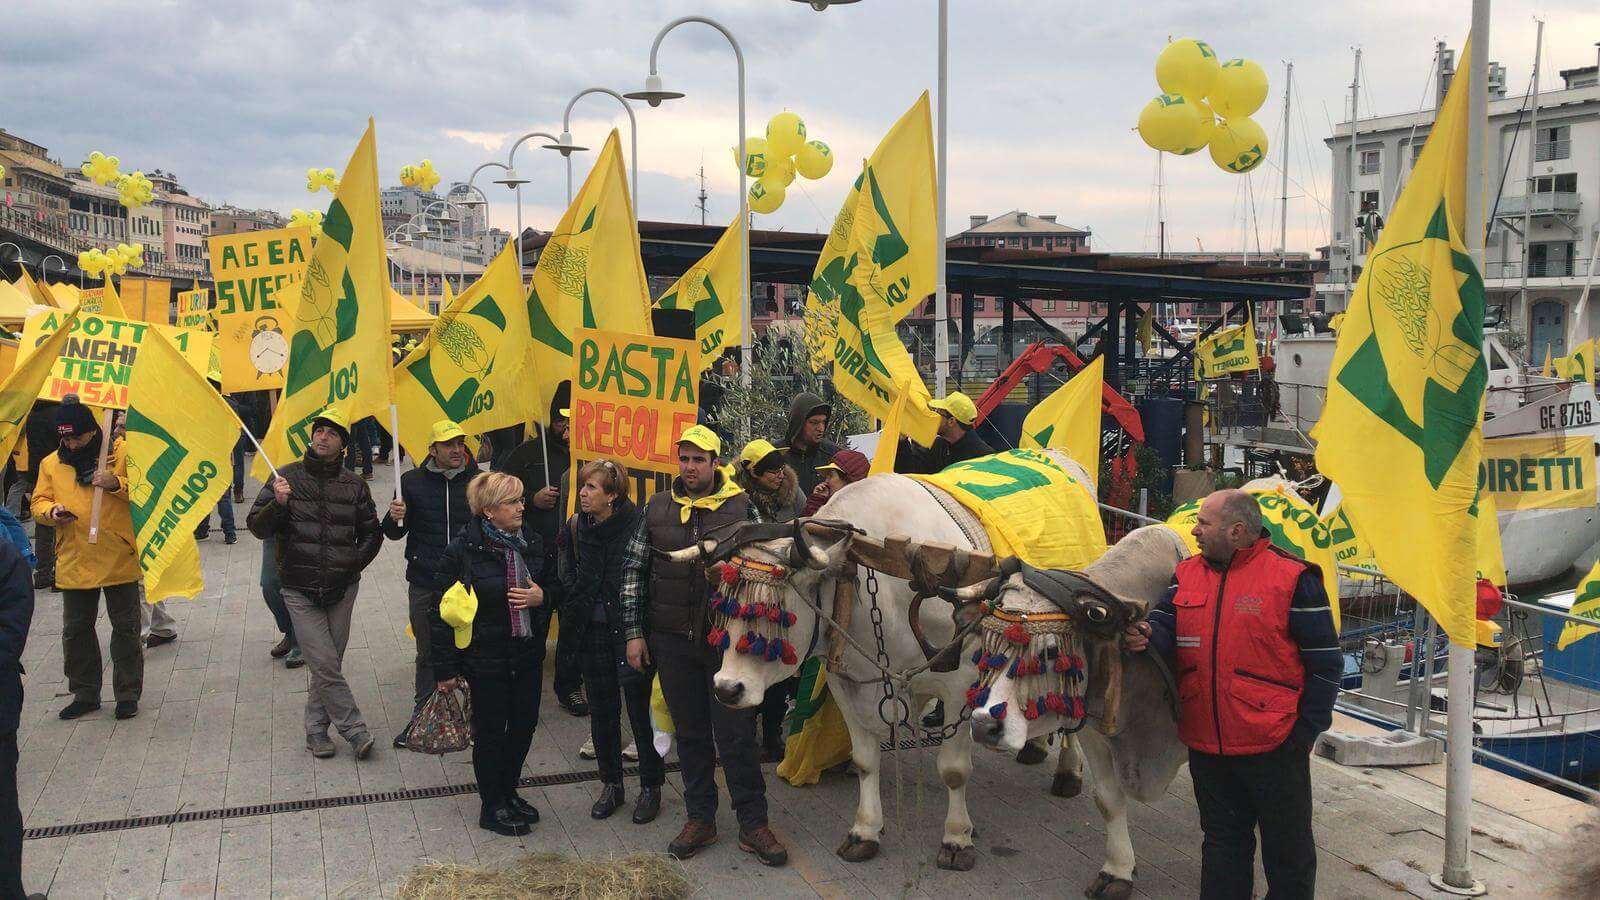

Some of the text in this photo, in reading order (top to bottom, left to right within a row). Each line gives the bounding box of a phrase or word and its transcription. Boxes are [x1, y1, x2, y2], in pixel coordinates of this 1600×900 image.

[221, 238, 305, 270] AGEA
[578, 338, 696, 404] BASTA
[1540, 400, 1592, 429] GE 8759
